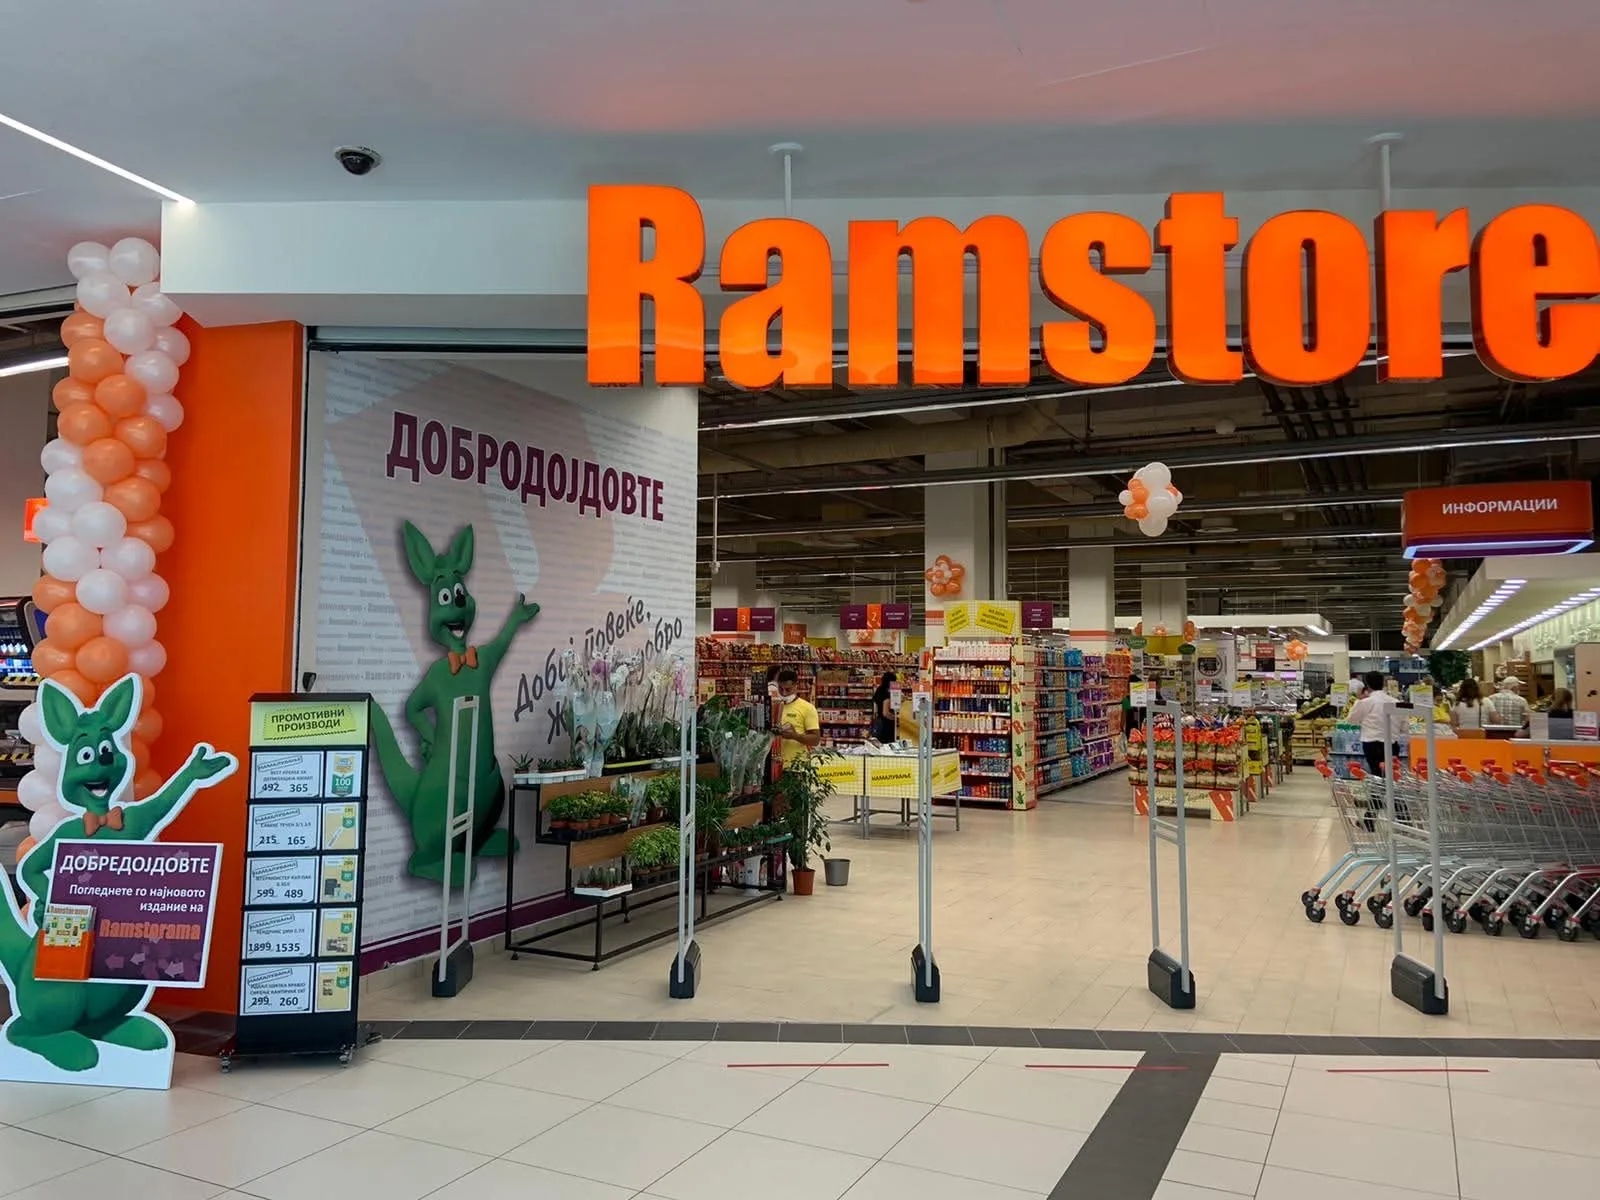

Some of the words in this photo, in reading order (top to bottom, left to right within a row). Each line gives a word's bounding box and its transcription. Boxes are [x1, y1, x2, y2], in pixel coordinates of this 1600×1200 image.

[586, 183, 1600, 389] Ramstore
[386, 411, 665, 522] ДОБРОДОЈДОВТЕ
[1442, 498, 1559, 515] ИНФОРМАЦИИ
[271, 708, 345, 724] ПРОМОТИВНИ
[276, 719, 341, 733] ПРОИЗВОДИ
[871, 773, 912, 782] НАМАЛУВАЊЕ
[261, 782, 281, 792] 492
[289, 783, 308, 793] 365
[259, 834, 277, 845] 215
[287, 836, 306, 846] 165
[59, 855, 210, 877] ДОБРЕДОЈДОВТЕ
[69, 884, 133, 897] Погледнете
[135, 887, 147, 897] го
[149, 887, 206, 899] најновото
[256, 888, 275, 898] 599
[284, 889, 304, 899] 489
[140, 901, 187, 913] издание
[190, 904, 204, 913] на
[100, 918, 201, 940] Ramstorama
[248, 941, 272, 952] 1899
[275, 942, 301, 953] 1535
[251, 995, 270, 1006] 299
[279, 996, 299, 1007] 260
